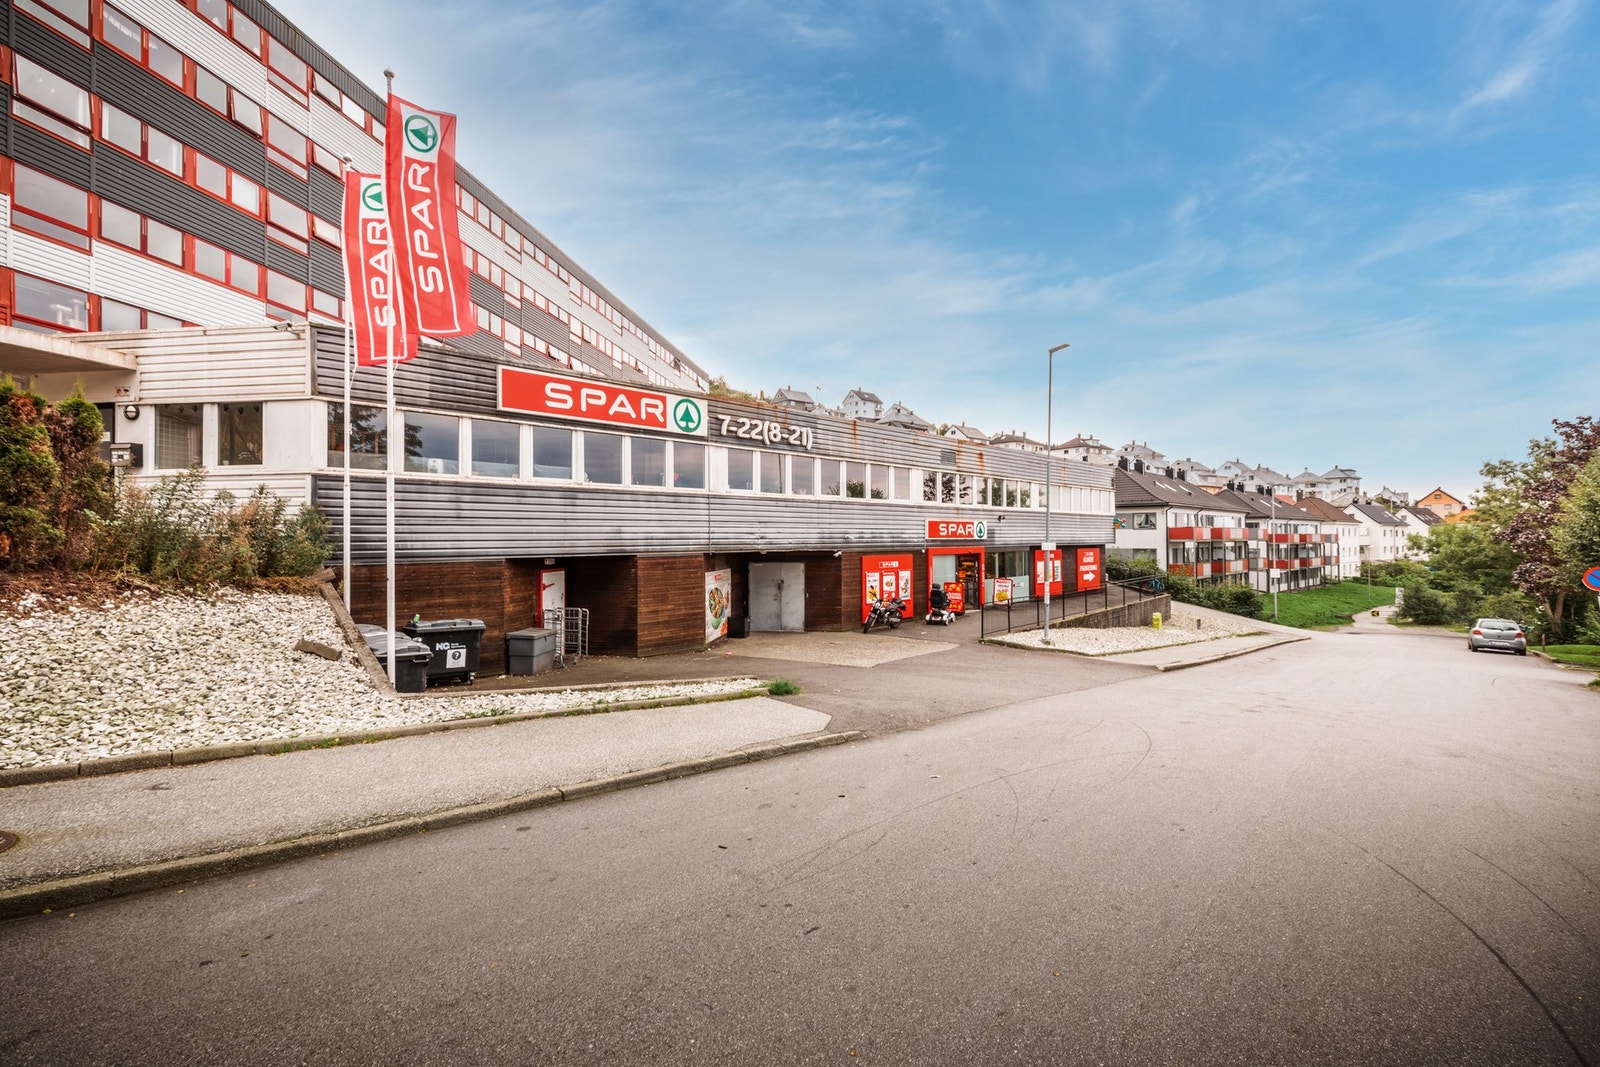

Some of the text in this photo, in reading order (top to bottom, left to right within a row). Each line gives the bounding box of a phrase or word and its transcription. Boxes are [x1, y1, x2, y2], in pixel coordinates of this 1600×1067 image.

[407, 162, 445, 294] SPAR
[366, 221, 397, 327] SPAR
[544, 381, 665, 423] SPAR
[717, 414, 813, 451] 7-22(8-21)
[938, 523, 975, 537] SPAR
[435, 641, 451, 651] NG
